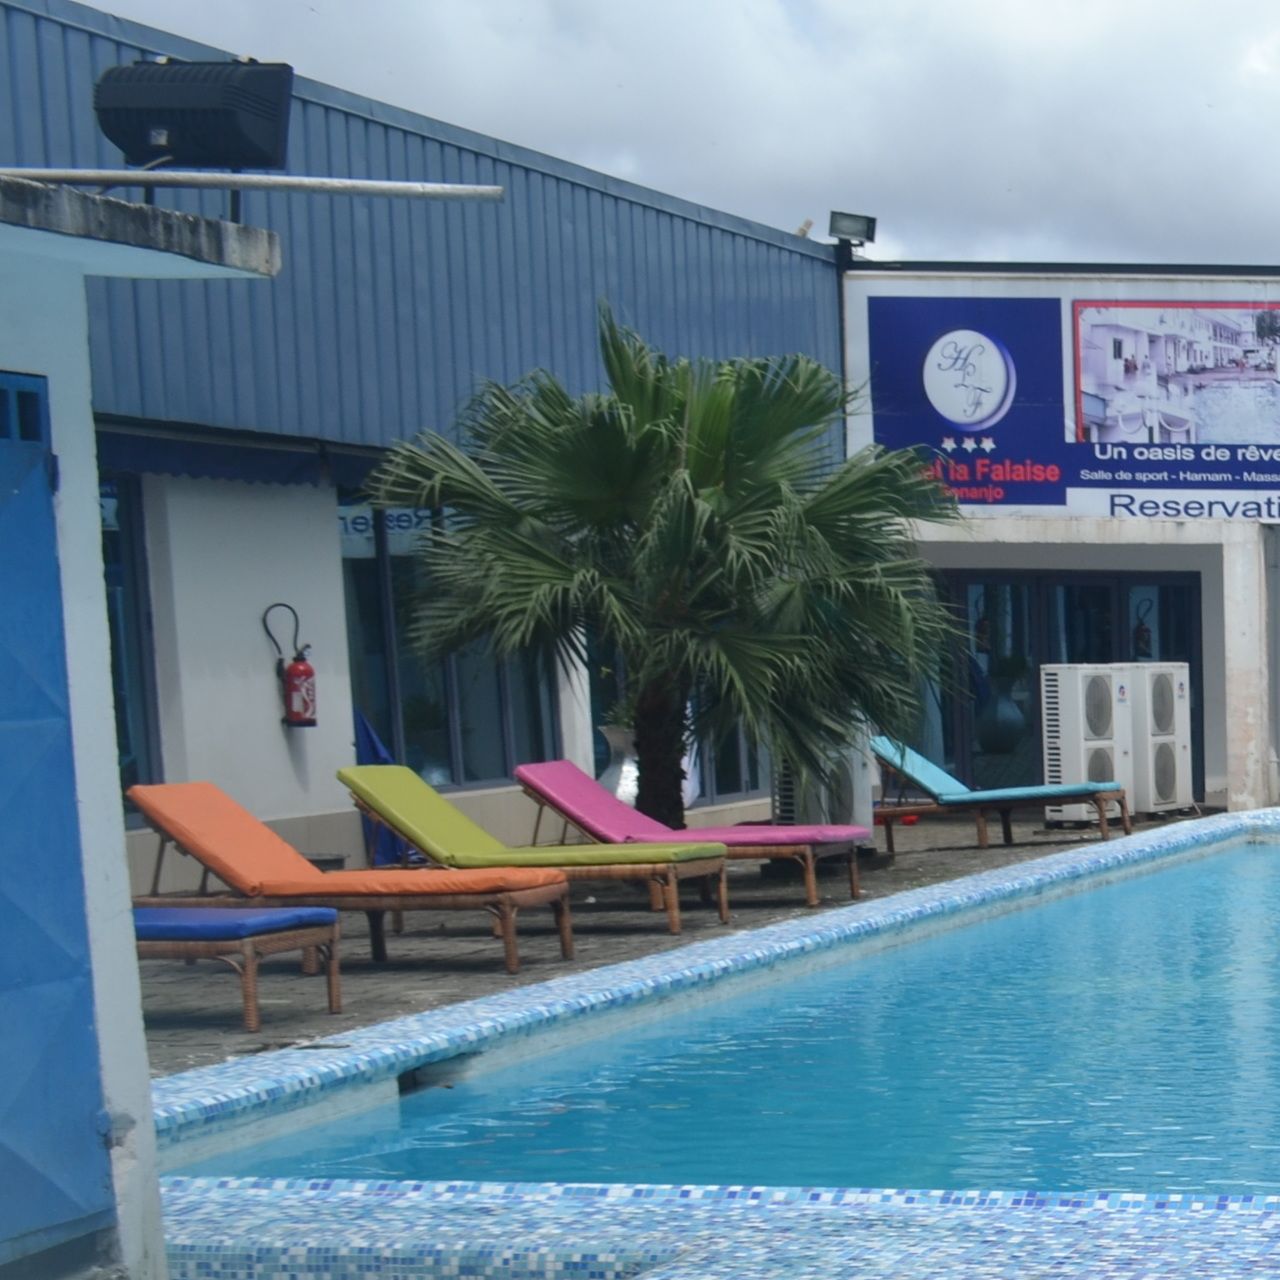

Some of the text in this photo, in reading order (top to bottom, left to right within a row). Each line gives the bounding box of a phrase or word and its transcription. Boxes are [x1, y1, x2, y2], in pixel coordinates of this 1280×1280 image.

[1095, 444, 1126, 459] Un
[1134, 445, 1194, 460] oasis
[1201, 446, 1230, 460] de
[976, 458, 1060, 482] Falaise
[1081, 470, 1112, 479] Salle
[1115, 471, 1132, 480] de
[1135, 472, 1168, 482] sport
[1180, 472, 1232, 481] Hamam
